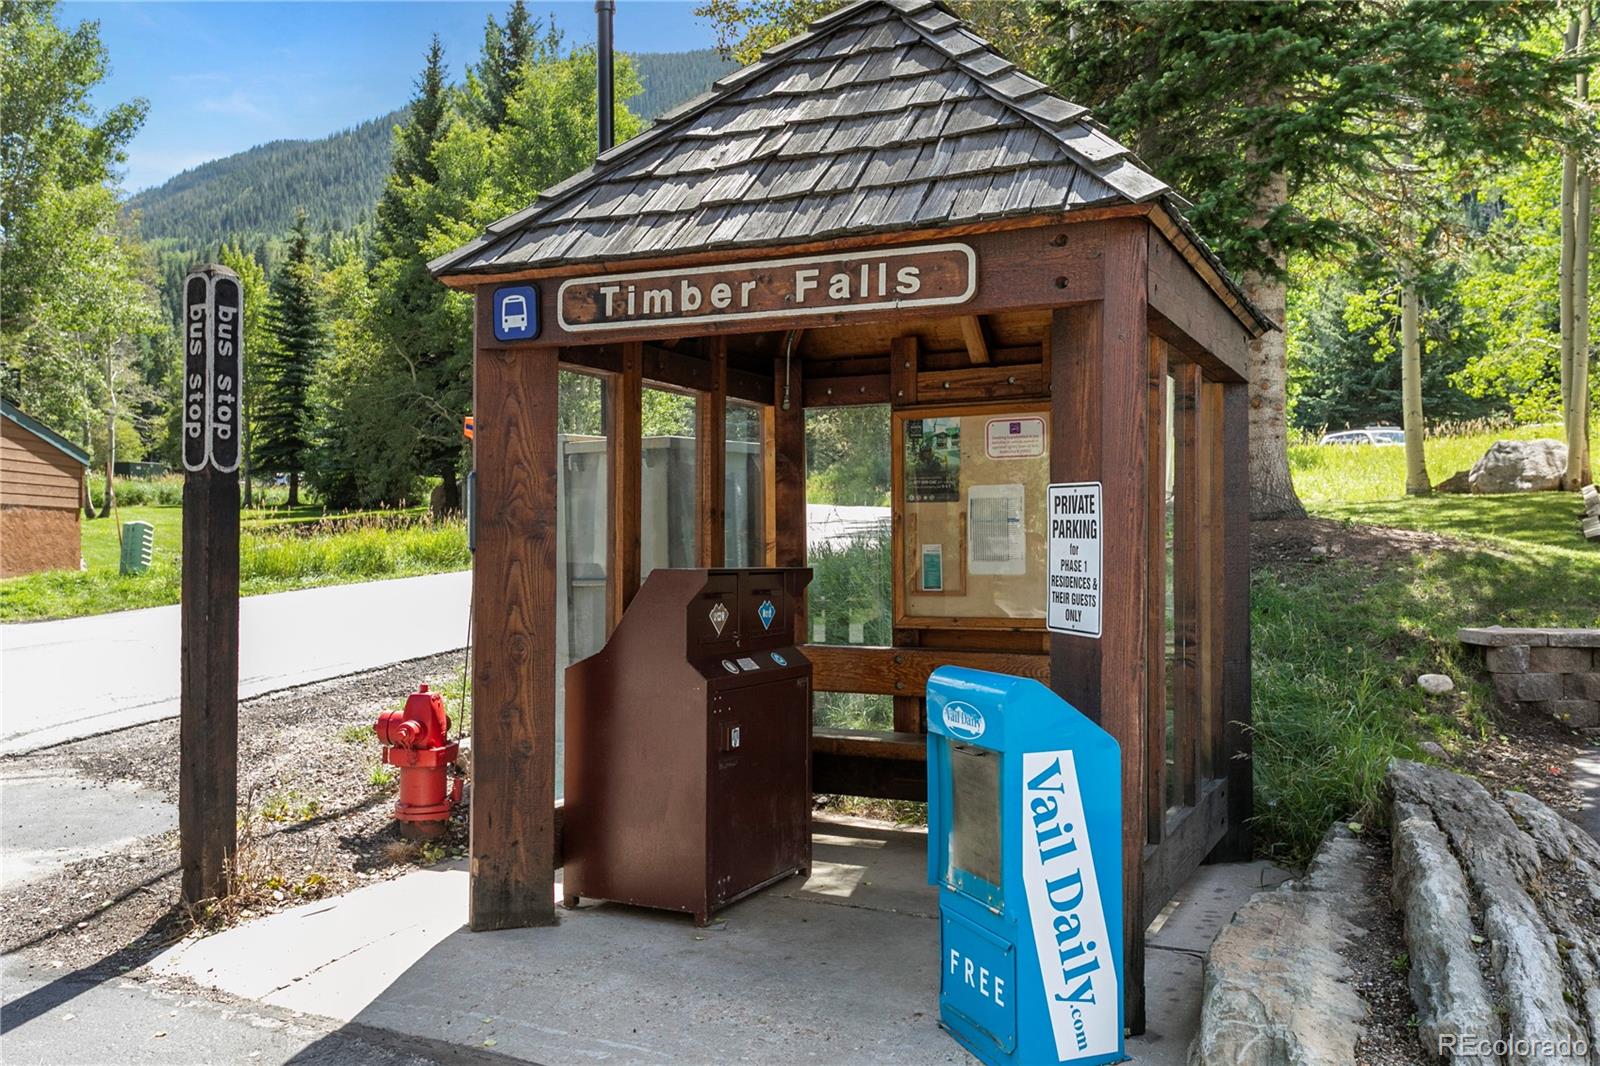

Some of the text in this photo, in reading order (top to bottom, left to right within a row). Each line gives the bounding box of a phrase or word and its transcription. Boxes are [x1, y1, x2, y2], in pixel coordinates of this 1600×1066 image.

[600, 263, 921, 315] Timber Falls
[185, 303, 206, 438] bus stop
[213, 305, 237, 440] bus stop
[1054, 494, 1095, 515] PRIVATE
[1052, 519, 1097, 540] PARKING
[1069, 543, 1079, 556] for
[1060, 559, 1088, 573] PHASE 1
[1051, 575, 1098, 590] RESIDENCES &
[1052, 591, 1097, 608] THEIR GUESTS
[1065, 608, 1082, 622] ONLY
[945, 709, 960, 723] Vail
[1027, 757, 1078, 866] Vail
[950, 949, 1005, 1007] FREE
